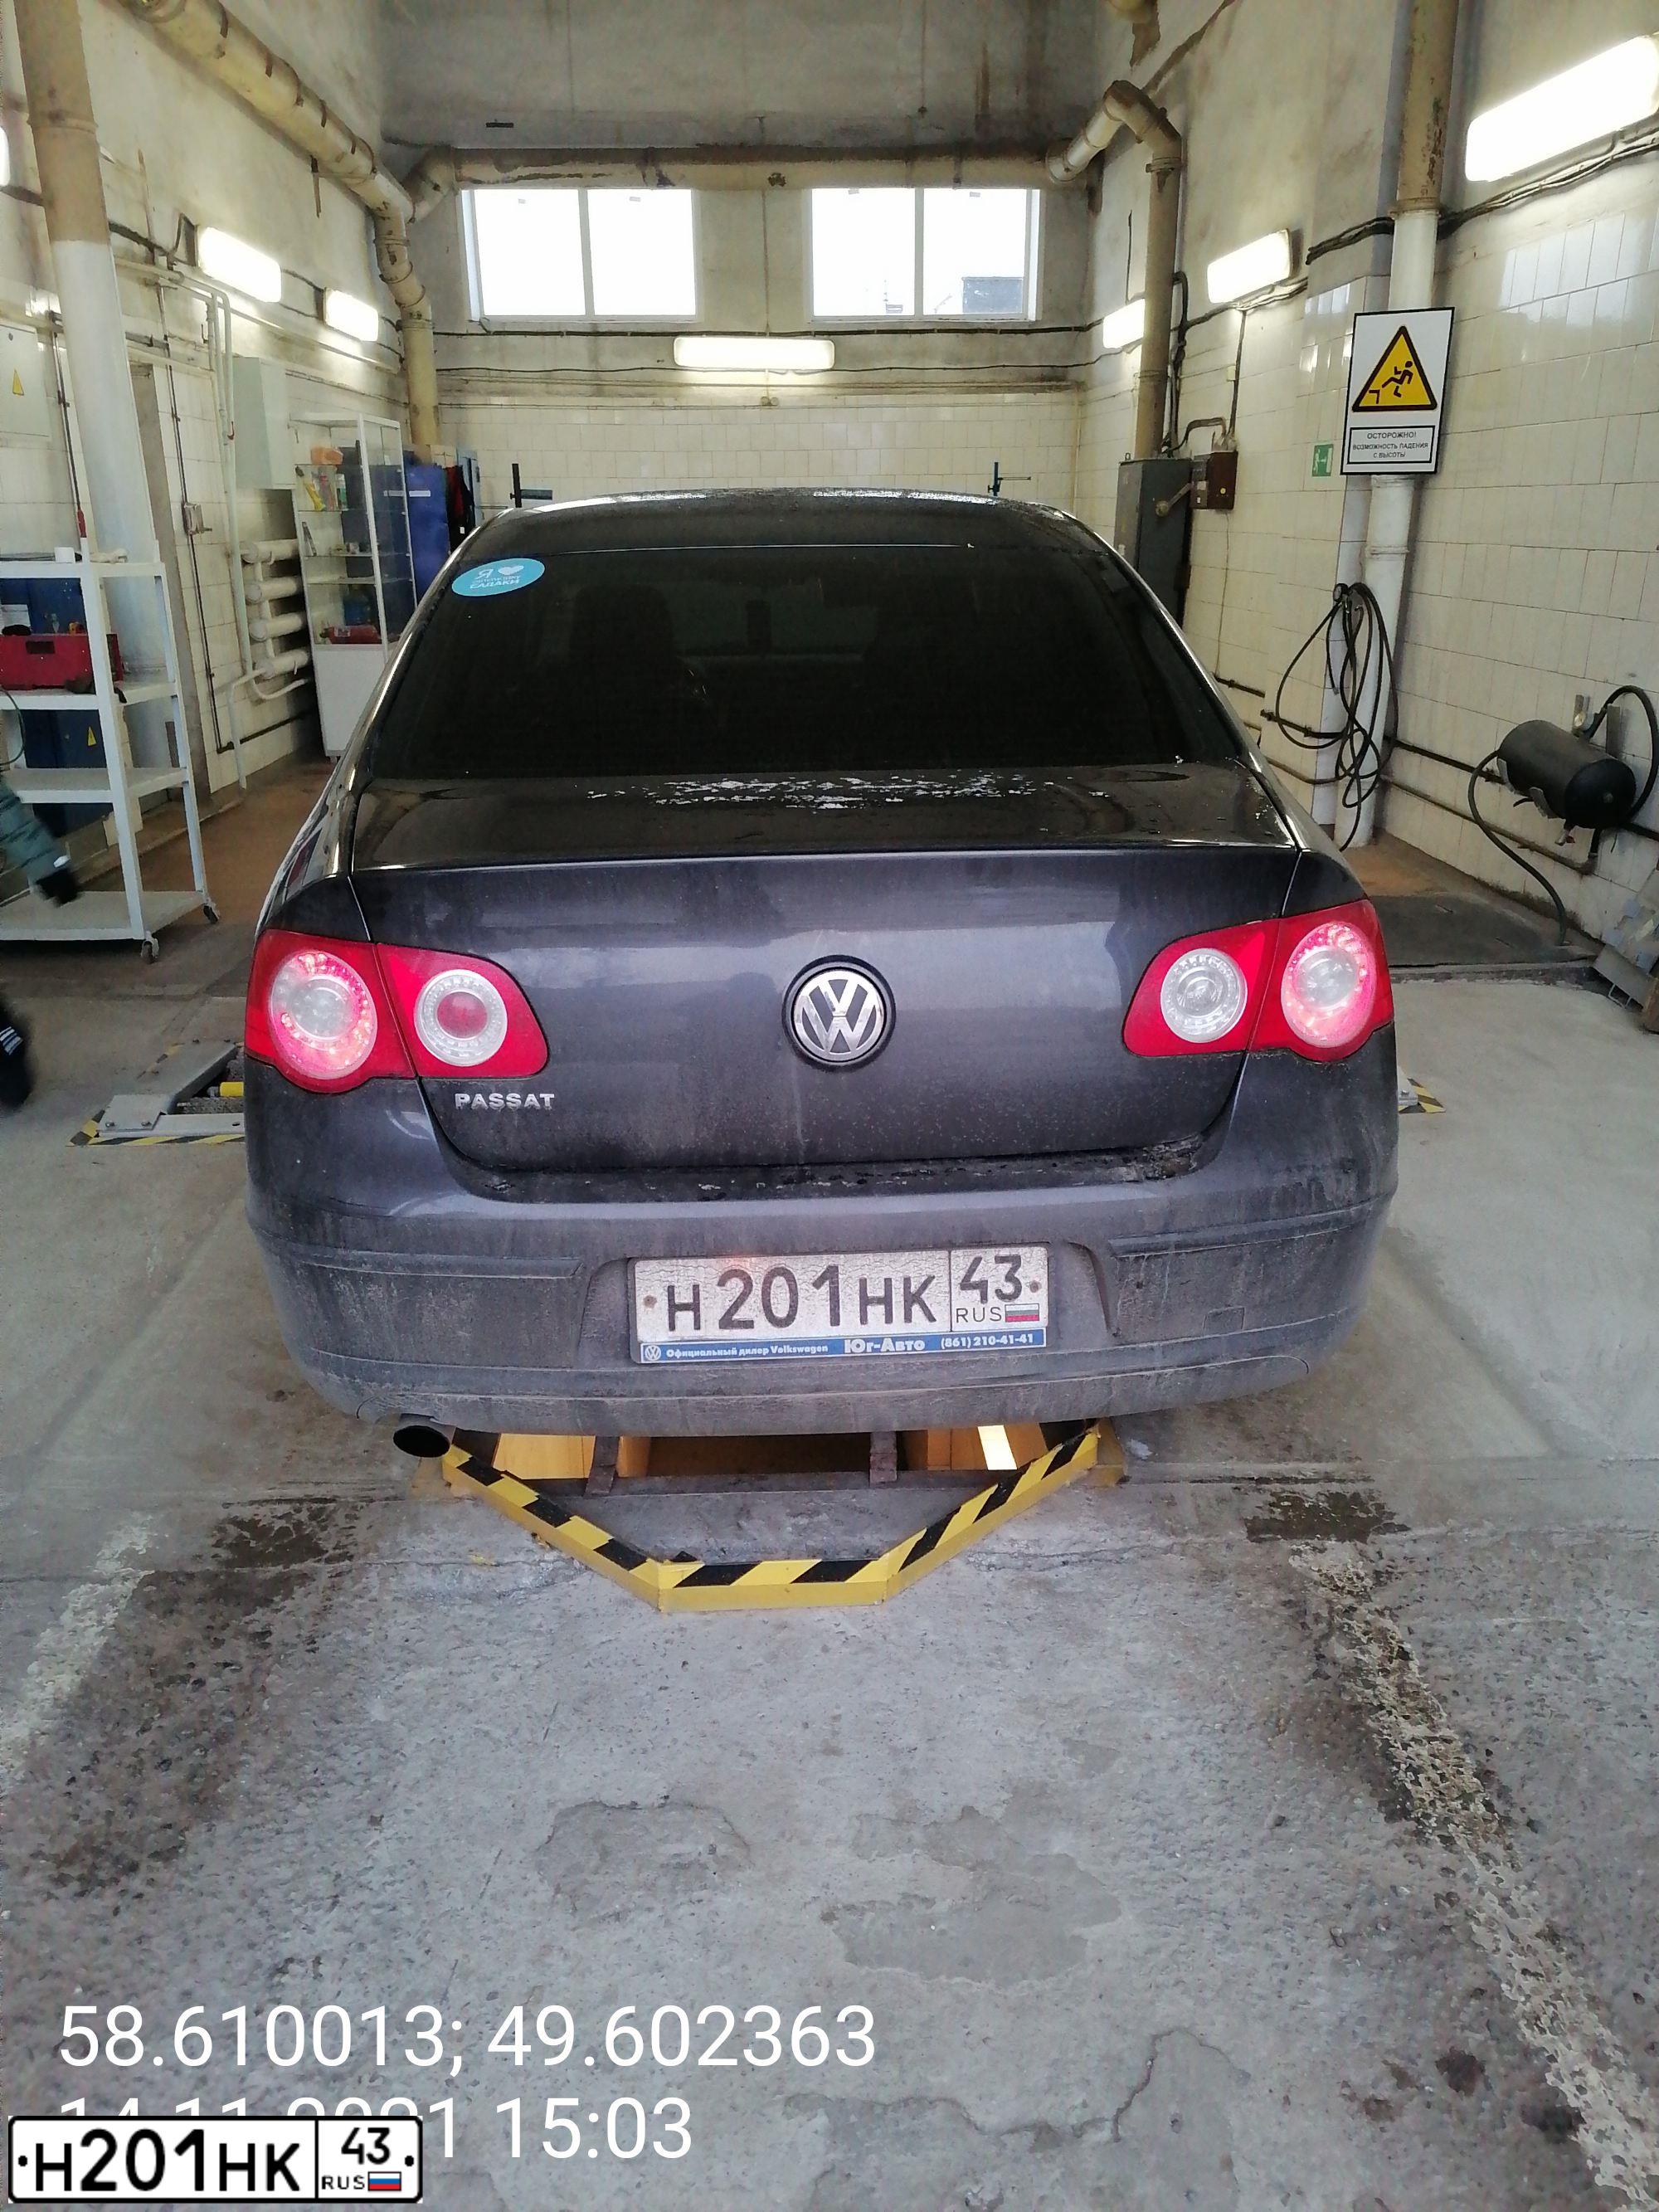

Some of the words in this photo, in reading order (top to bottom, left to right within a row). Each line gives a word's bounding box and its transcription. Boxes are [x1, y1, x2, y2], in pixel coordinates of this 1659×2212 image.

[1366, 431, 1417, 440] ОСТОРОЖНО!
[474, 568, 494, 580] Я
[454, 1093, 555, 1110] PASSAT
[959, 1254, 1023, 1305] 43
[956, 1307, 1002, 1323] RUS
[844, 1338, 926, 1354] Юг-Авто
[940, 1336, 971, 1350] (861)
[973, 1333, 1034, 1347] 210-41-41
[665, 1347, 737, 1359] Официальный
[738, 1347, 769, 1357] дилер
[770, 1344, 829, 1355] Volkswagen
